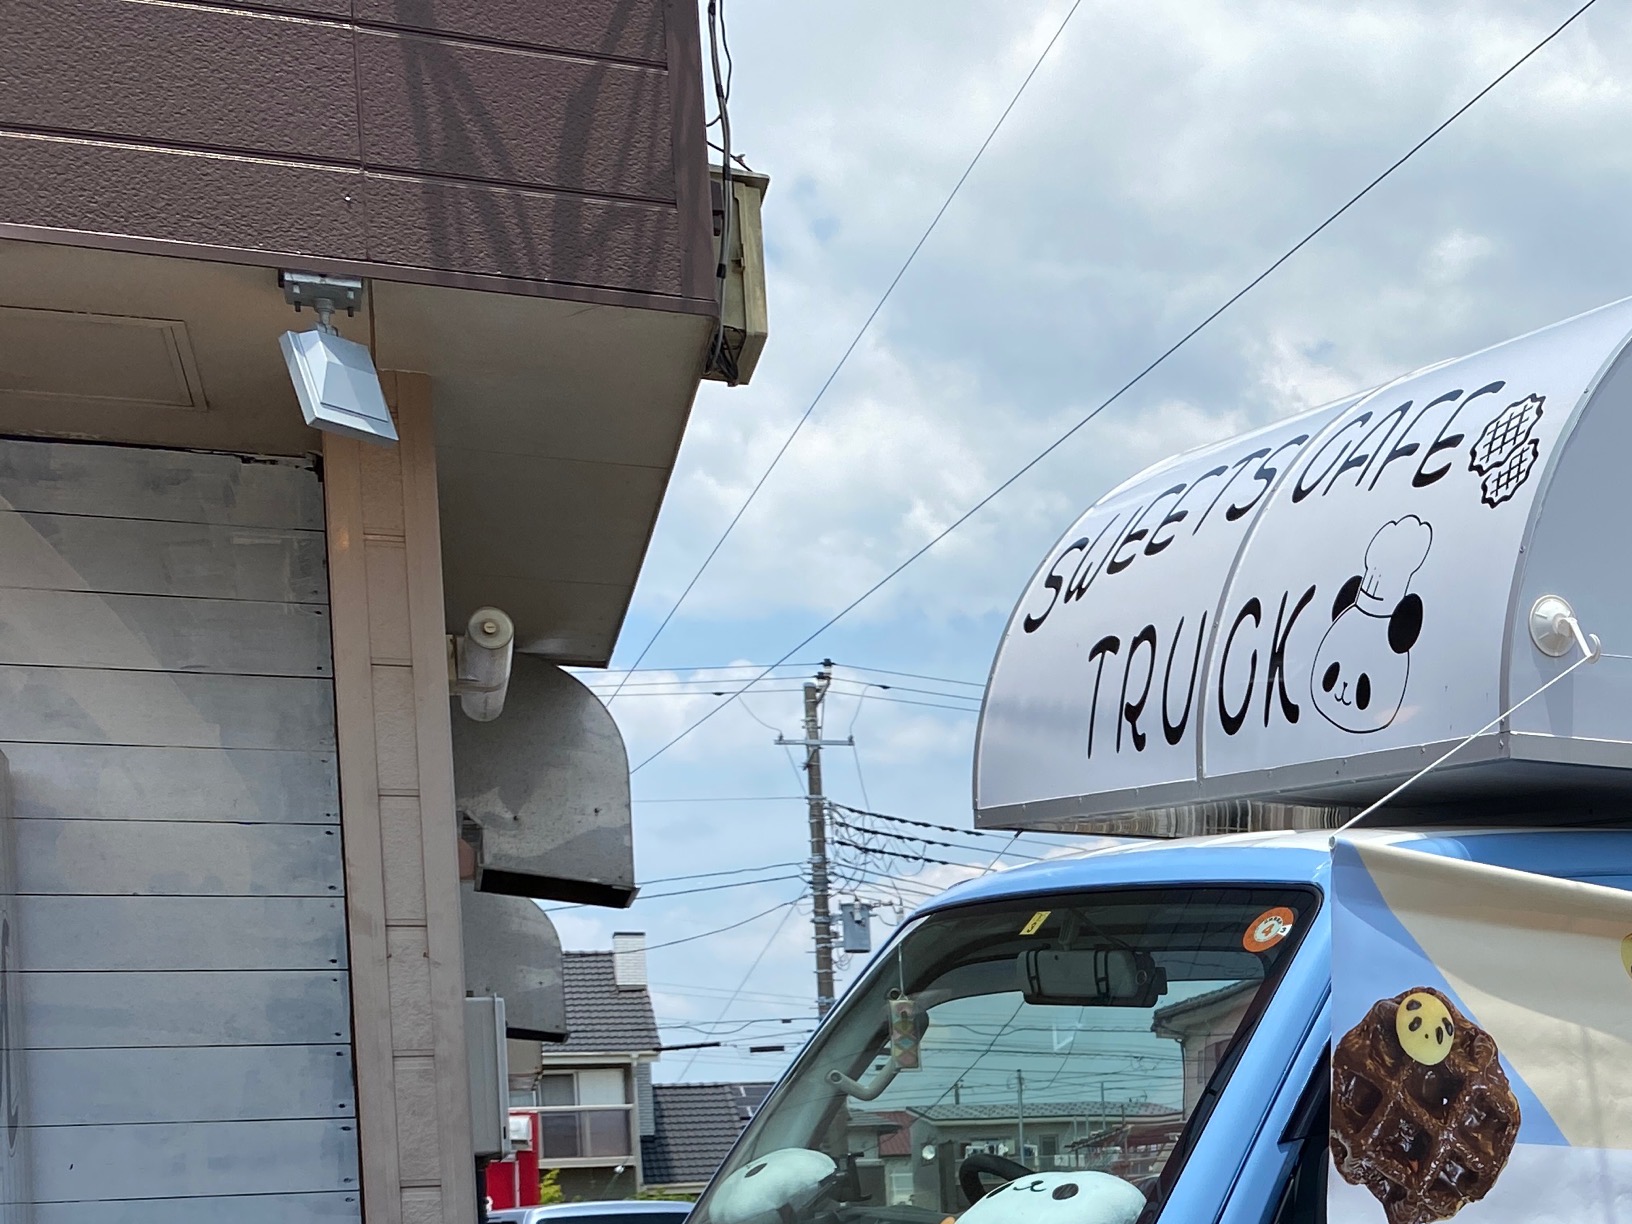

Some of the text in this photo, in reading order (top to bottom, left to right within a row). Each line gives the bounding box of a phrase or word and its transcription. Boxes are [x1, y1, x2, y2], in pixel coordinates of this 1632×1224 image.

[1023, 380, 1507, 635] SWEETS CAFE
[1083, 583, 1316, 760] TRUCK
